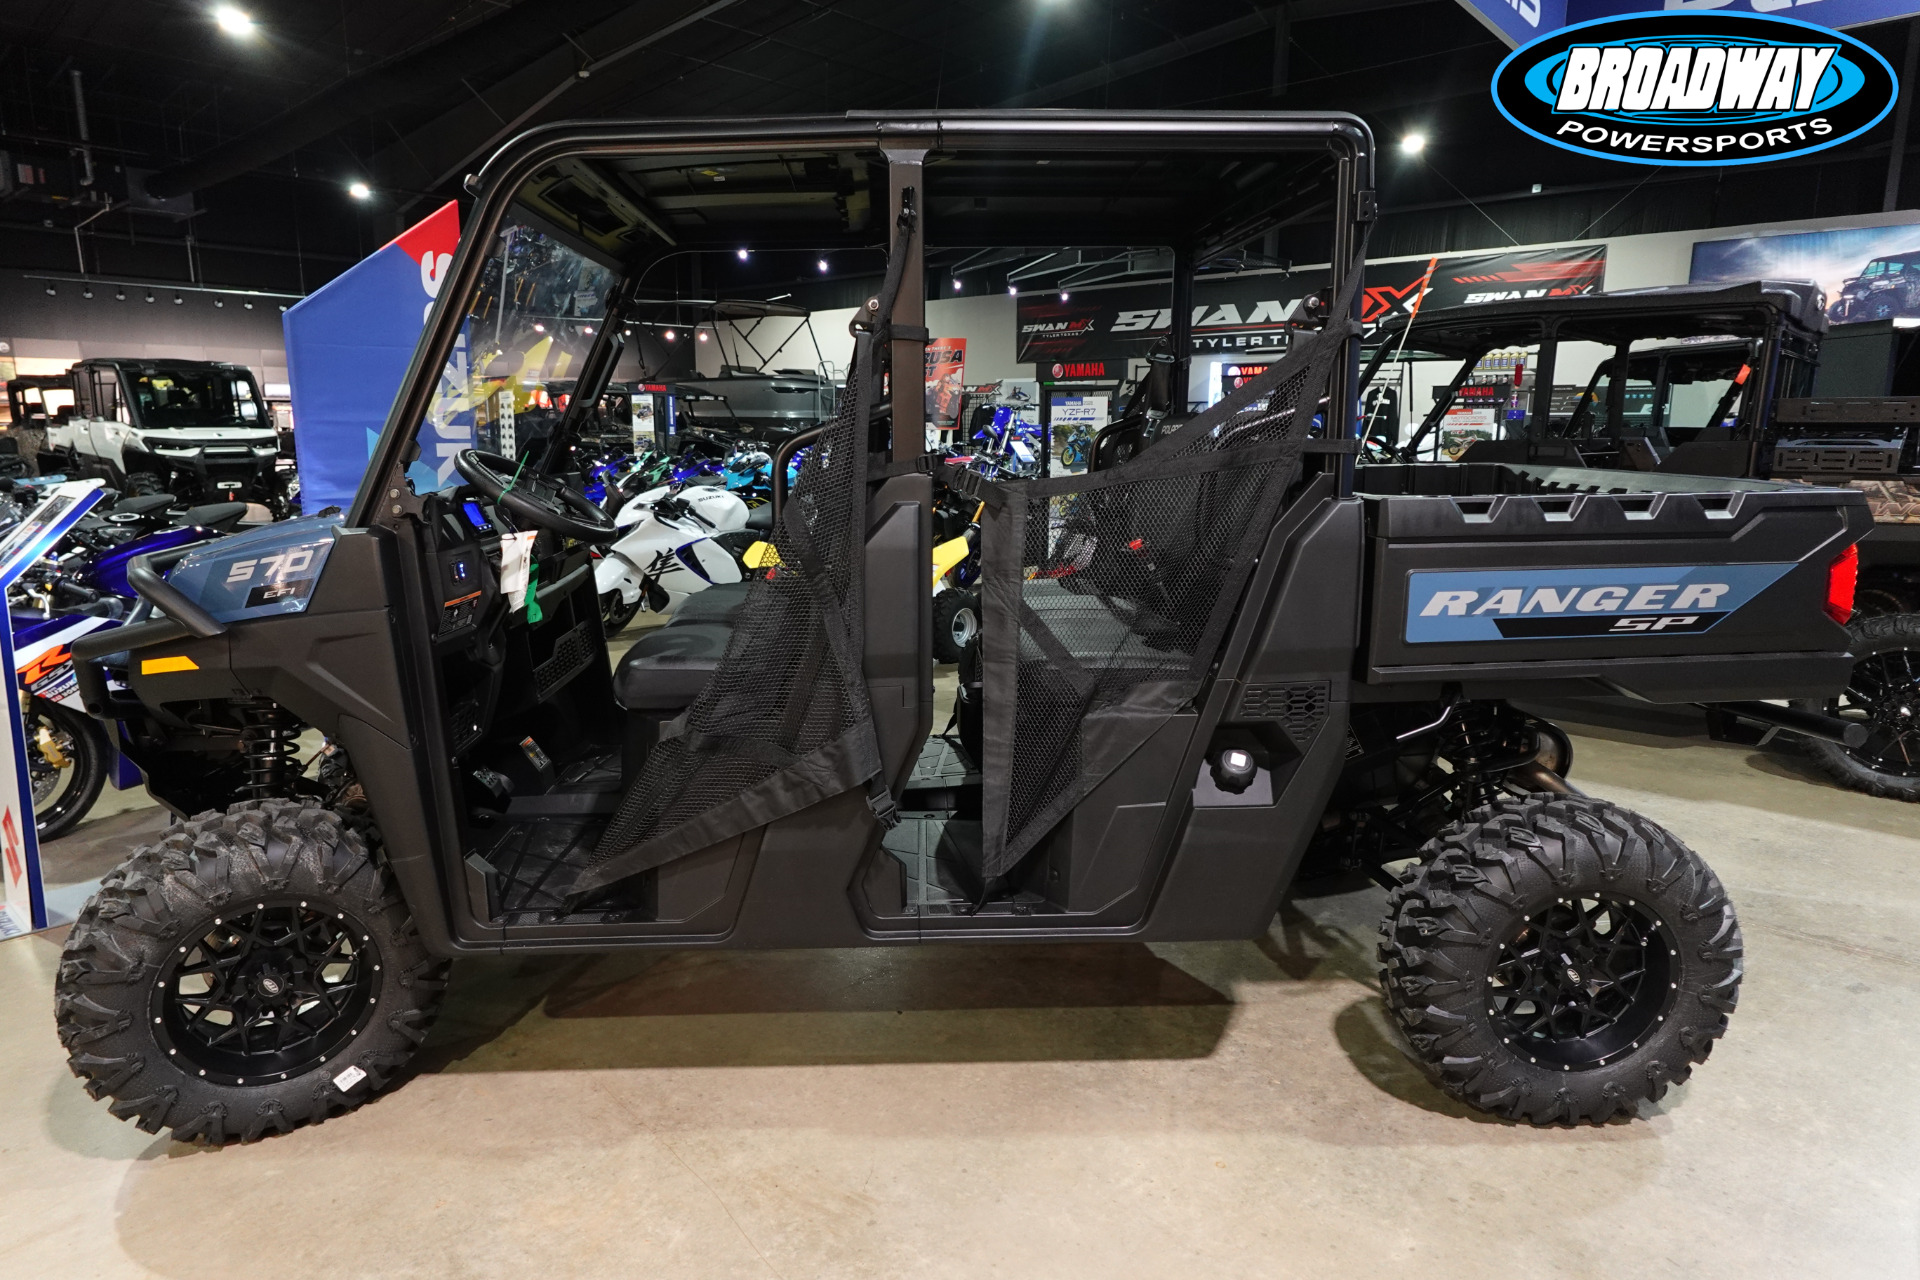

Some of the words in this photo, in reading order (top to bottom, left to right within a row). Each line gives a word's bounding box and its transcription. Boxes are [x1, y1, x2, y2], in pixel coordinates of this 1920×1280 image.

[1464, 288, 1548, 304] SWAN
[1021, 322, 1069, 333] SWAN
[1192, 335, 1265, 349] TYLER
[1064, 363, 1105, 377] YAMAHA
[1241, 366, 1269, 376] YAM
[644, 384, 667, 392] YAMAHA
[1459, 386, 1494, 397] YAMAHA
[1062, 408, 1096, 416] YZF-R7
[226, 550, 314, 583] 570
[262, 587, 296, 599] EFI
[1419, 583, 1730, 616] RANGER
[1608, 616, 1700, 632] SP
[44, 680, 78, 699] SUZUK
